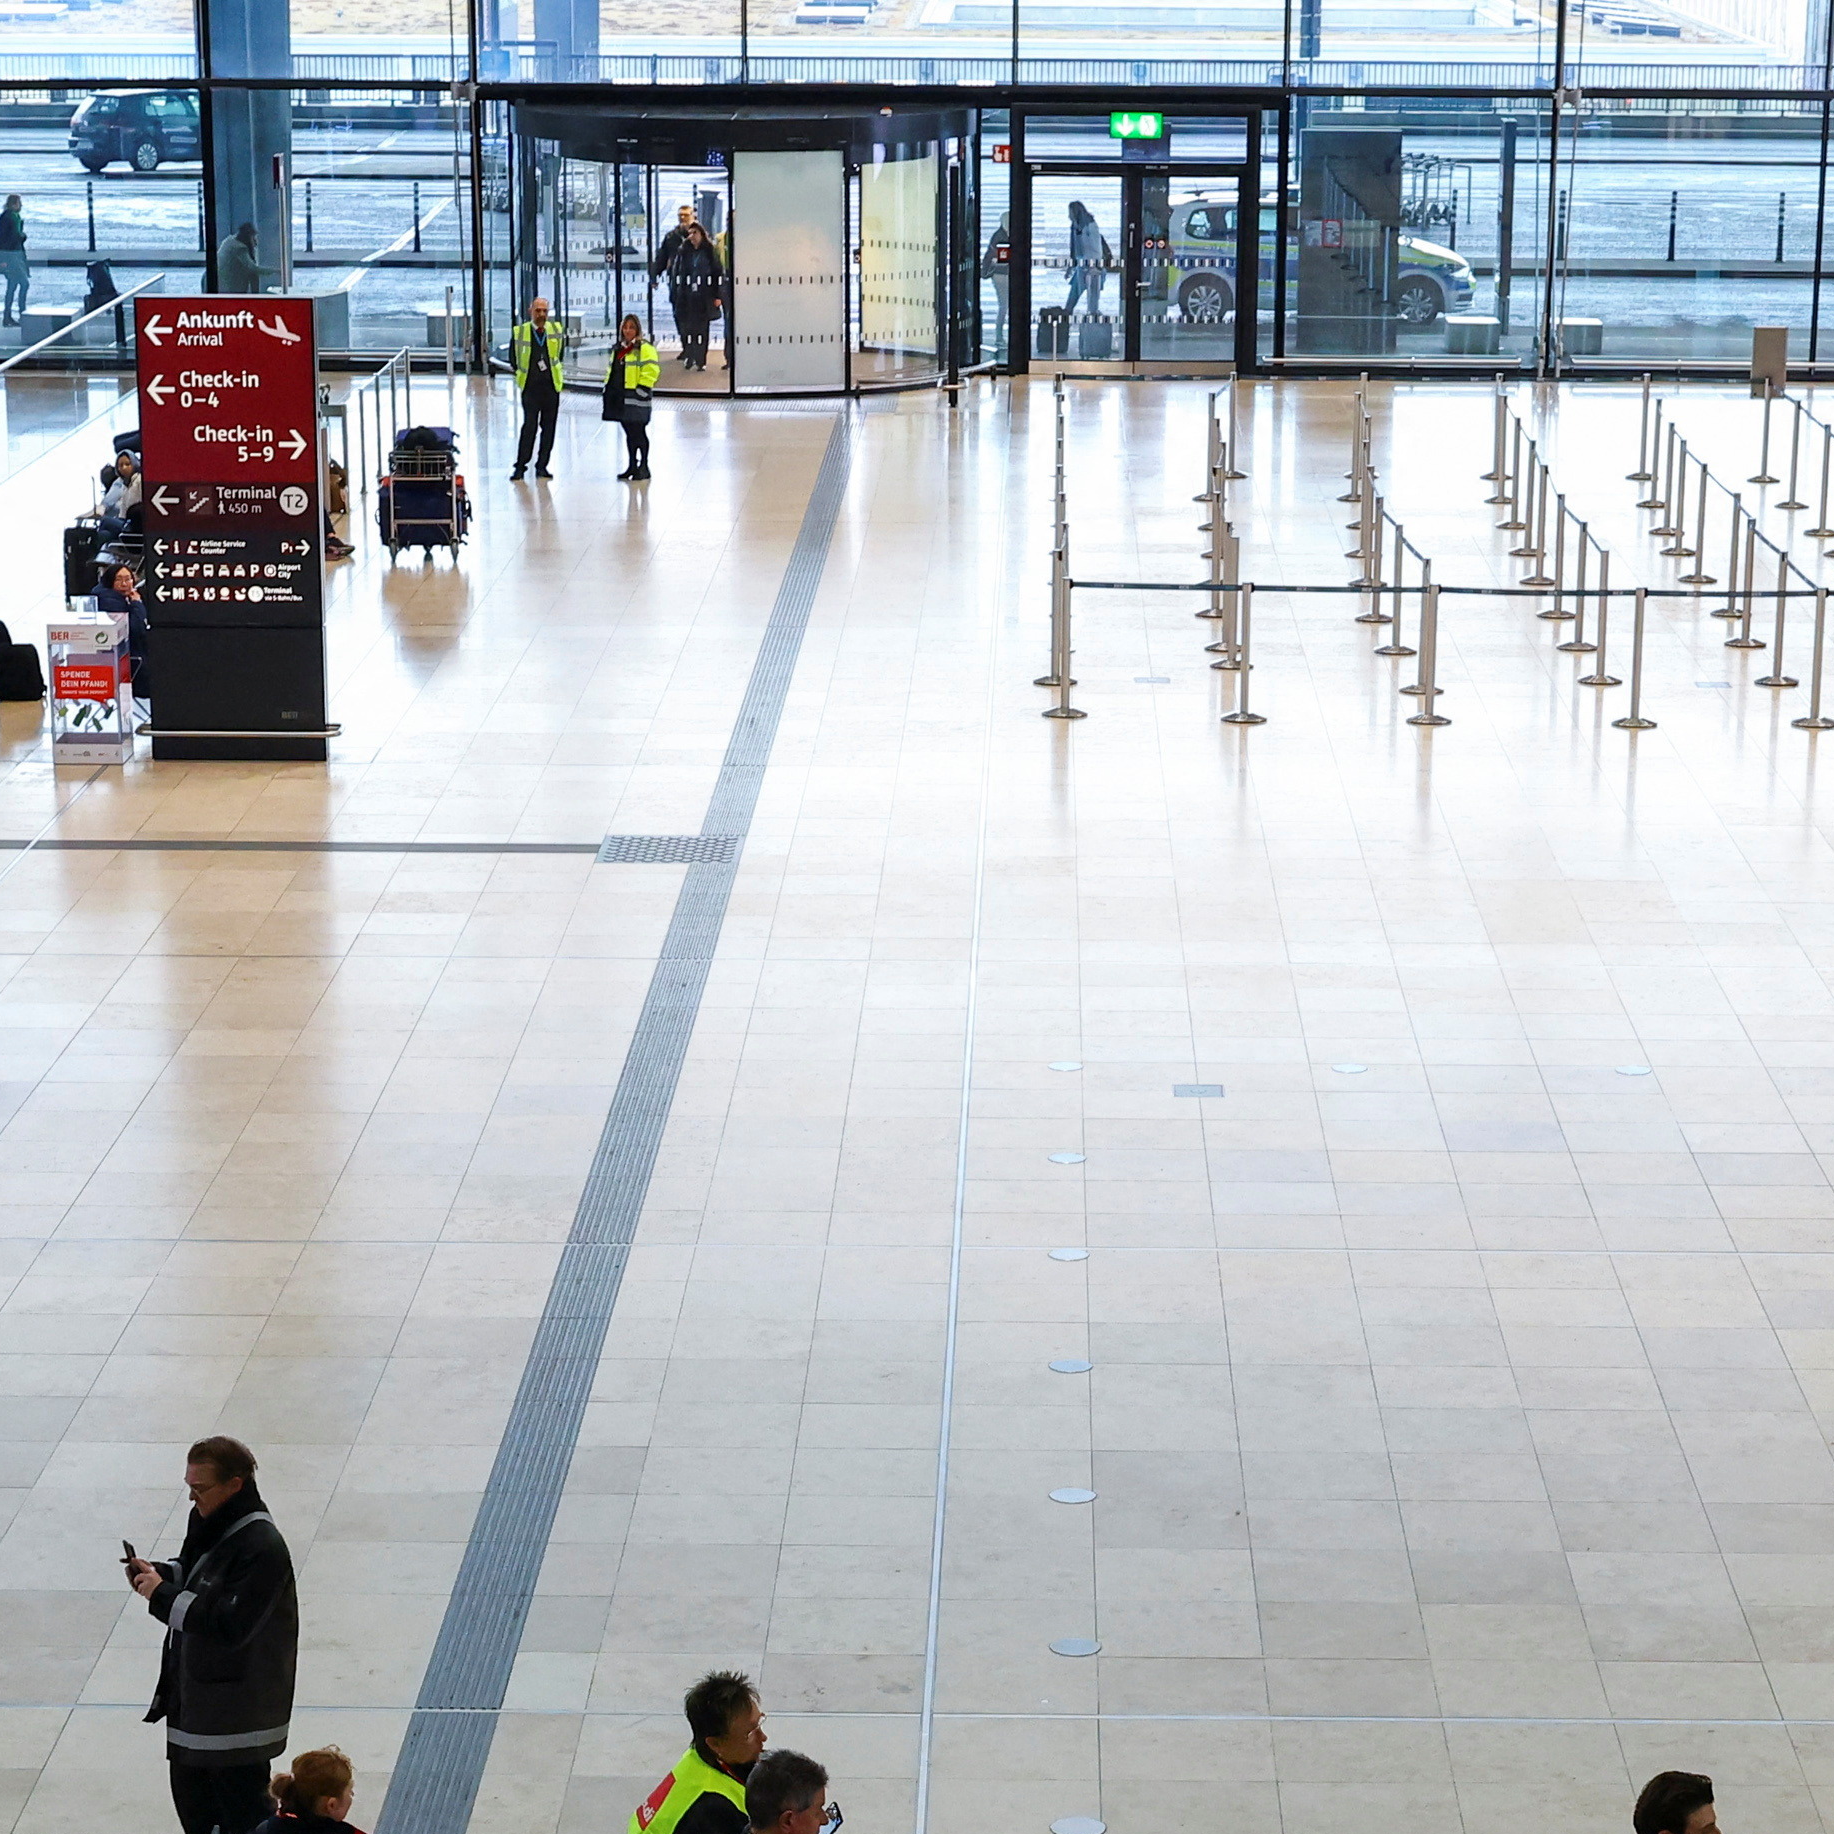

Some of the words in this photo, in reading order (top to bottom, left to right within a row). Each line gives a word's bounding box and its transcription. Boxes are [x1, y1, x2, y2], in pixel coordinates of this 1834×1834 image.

[176, 311, 255, 329] Ankunft
[177, 332, 223, 347] Arrival
[179, 370, 259, 388] Check-in
[193, 425, 273, 442] Check-in
[216, 486, 277, 500] Terminal
[284, 494, 304, 508] T2
[228, 503, 248, 514] 450
[251, 505, 262, 514] m
[200, 540, 222, 548] Airline
[223, 540, 246, 548] Service
[281, 542, 293, 553] P1
[278, 564, 301, 572] Airport
[50, 631, 69, 640] BER
[60, 680, 79, 688] DEIN
